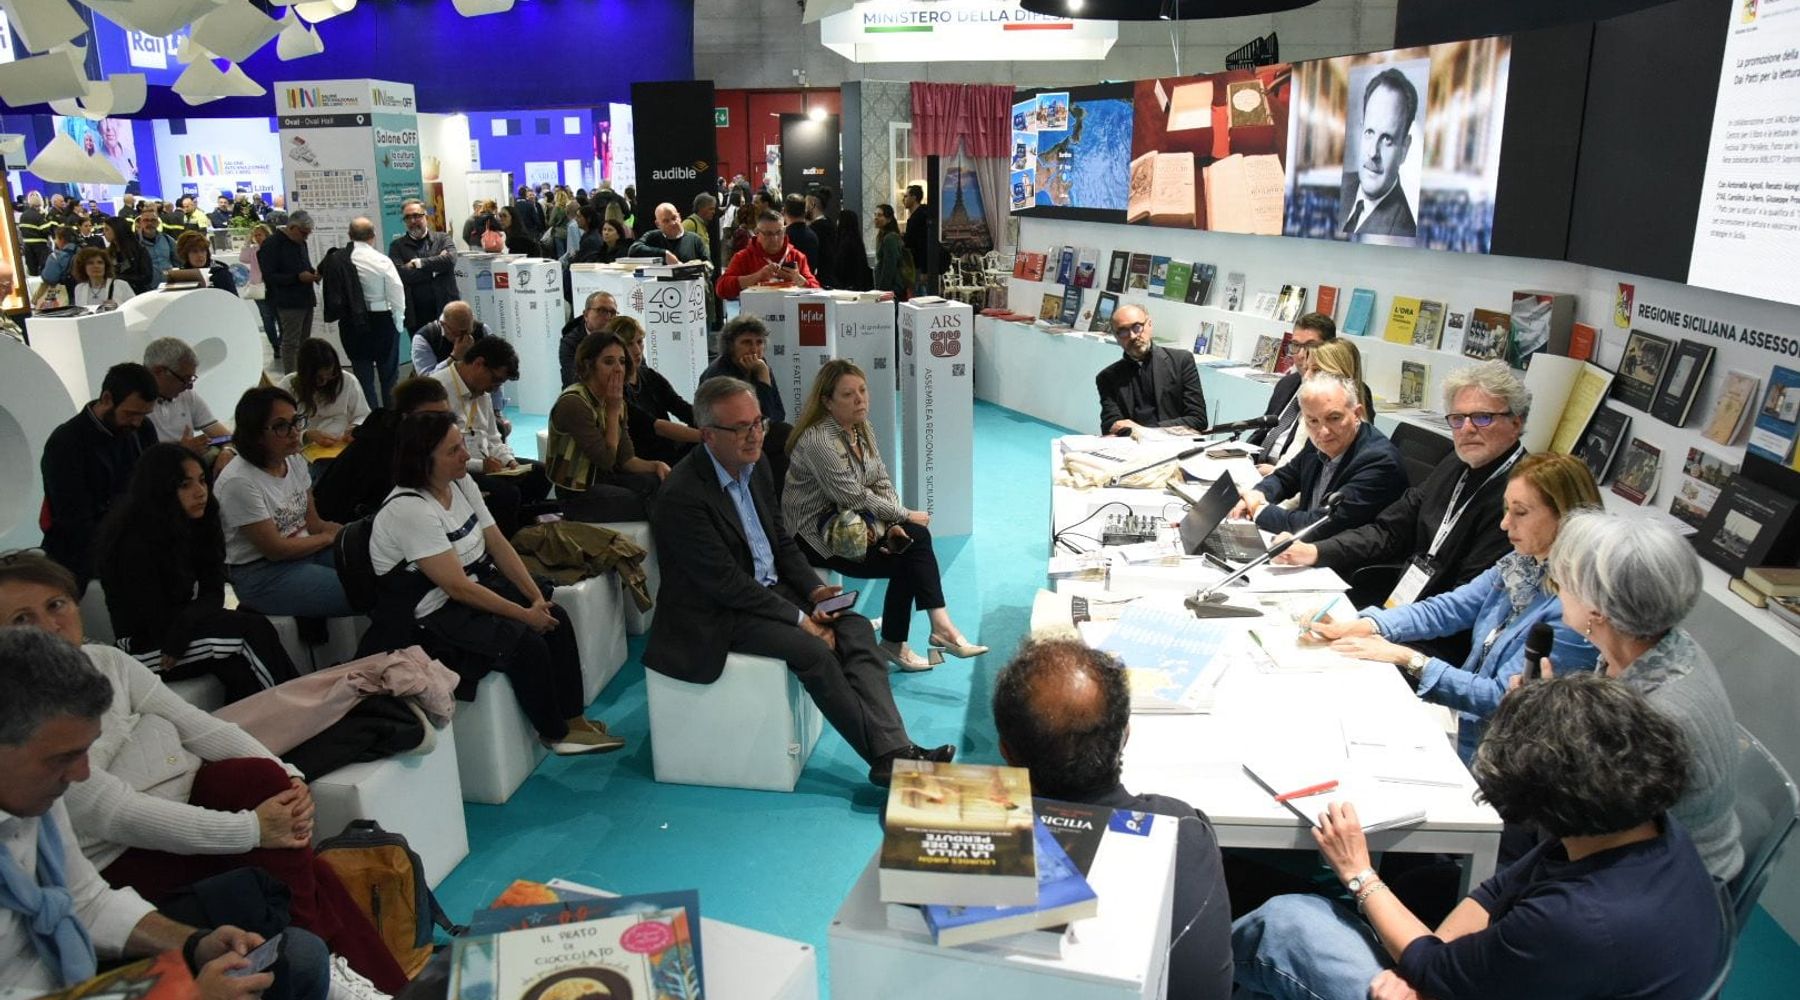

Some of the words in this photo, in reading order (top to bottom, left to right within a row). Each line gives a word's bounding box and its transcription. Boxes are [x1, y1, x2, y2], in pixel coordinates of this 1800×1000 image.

[864, 11, 951, 24] MINISTERO
[957, 10, 1009, 22] DELLA
[376, 131, 401, 145] Salone
[402, 132, 416, 145] OFF
[652, 166, 696, 180] audible
[649, 310, 683, 324] DUE
[929, 314, 961, 328] ARS
[1637, 303, 1681, 326] REGIONE
[1682, 314, 1737, 341] SICILIANA
[1738, 328, 1800, 357] ASSESSO
[793, 365, 801, 386] FATE
[924, 368, 933, 420] ASSEMBLEA
[925, 422, 934, 472] REGIONALE
[925, 475, 935, 516] SICILIANA
[1039, 815, 1094, 831] SICILIA
[921, 838, 949, 849] DEE
[926, 833, 992, 844] PERDUTE
[952, 840, 996, 851] DELLE
[926, 848, 967, 858] VILLA
[969, 849, 991, 859] LA
